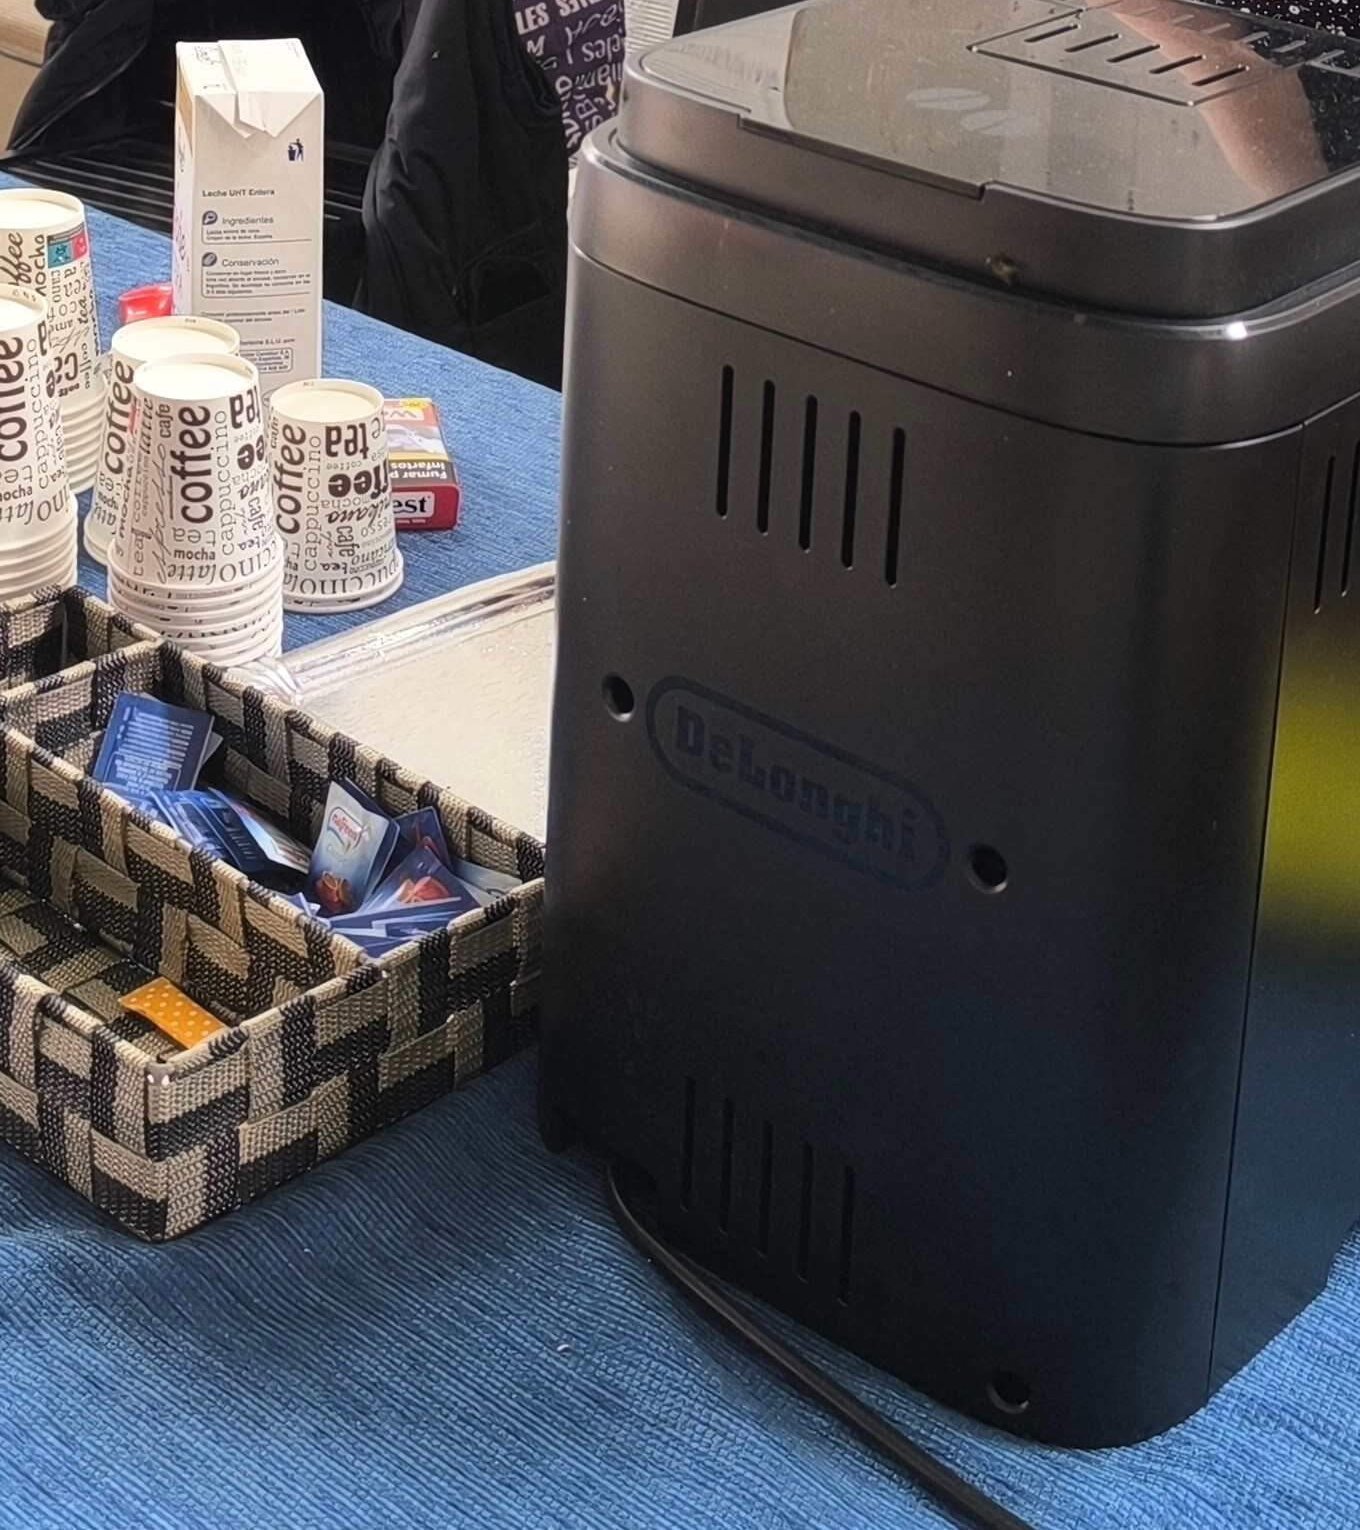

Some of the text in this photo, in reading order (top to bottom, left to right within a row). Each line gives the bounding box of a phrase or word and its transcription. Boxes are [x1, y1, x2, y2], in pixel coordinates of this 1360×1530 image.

[202, 188, 275, 198] Leche UHT Entera
[222, 216, 275, 227] Ingredientes
[221, 257, 280, 268] Conservación
[26, 338, 50, 490] cappuccino
[104, 359, 134, 475] coffee
[156, 403, 174, 438] cafe
[325, 422, 370, 460] tea
[170, 405, 214, 524] coffee
[326, 460, 363, 470] coffee
[390, 461, 446, 469] Infartos
[214, 410, 237, 556] cappuccino
[274, 423, 308, 535] coffee
[403, 471, 448, 480] Fumar
[303, 435, 323, 572] cappuccino
[321, 494, 373, 509] mocha
[173, 527, 216, 547] tea
[336, 525, 361, 558] cafe
[173, 547, 216, 560] mocha
[167, 564, 218, 586] latte
[320, 561, 348, 575] tea
